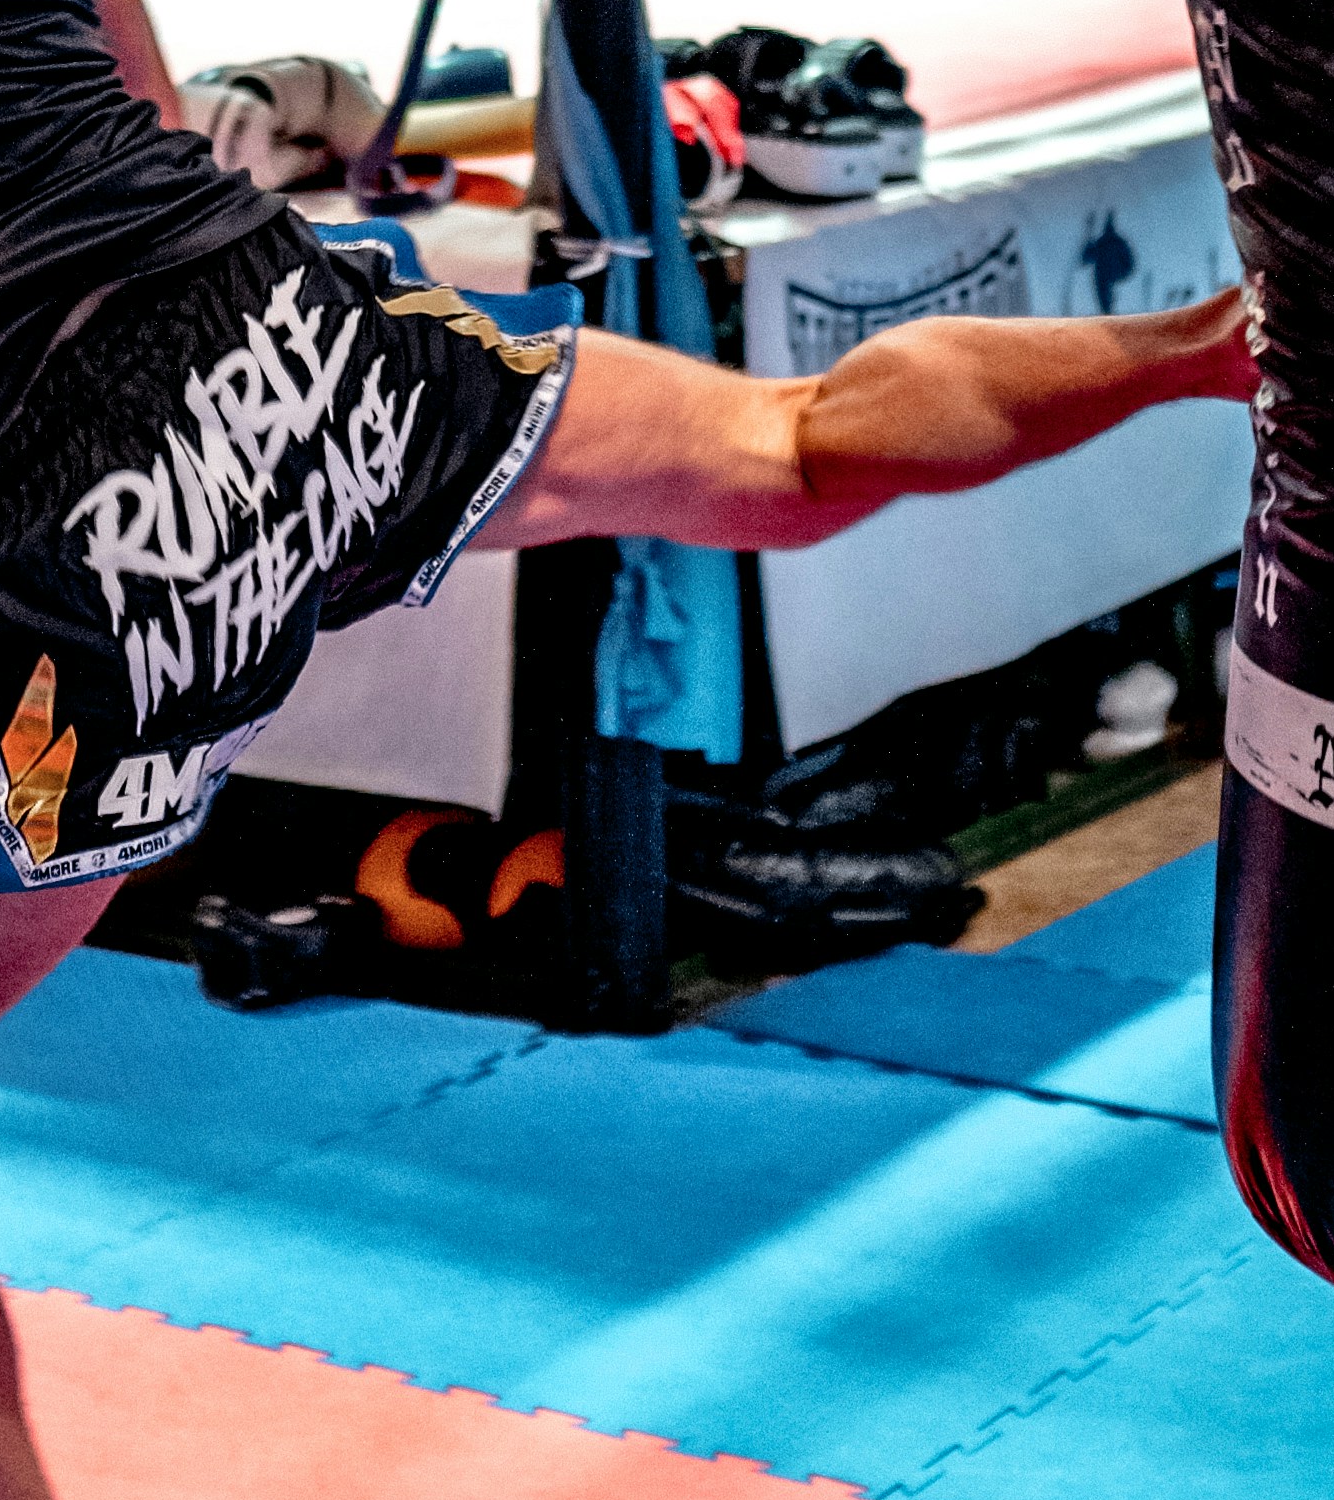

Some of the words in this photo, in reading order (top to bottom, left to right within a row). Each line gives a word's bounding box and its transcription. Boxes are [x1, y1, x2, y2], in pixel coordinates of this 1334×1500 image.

[63, 264, 364, 637] RUMBLE
[124, 576, 194, 737] IN
[184, 506, 321, 693] THE
[302, 353, 426, 572] CAGE
[470, 466, 512, 517] 4MORE
[28, 857, 81, 884] 4MORE
